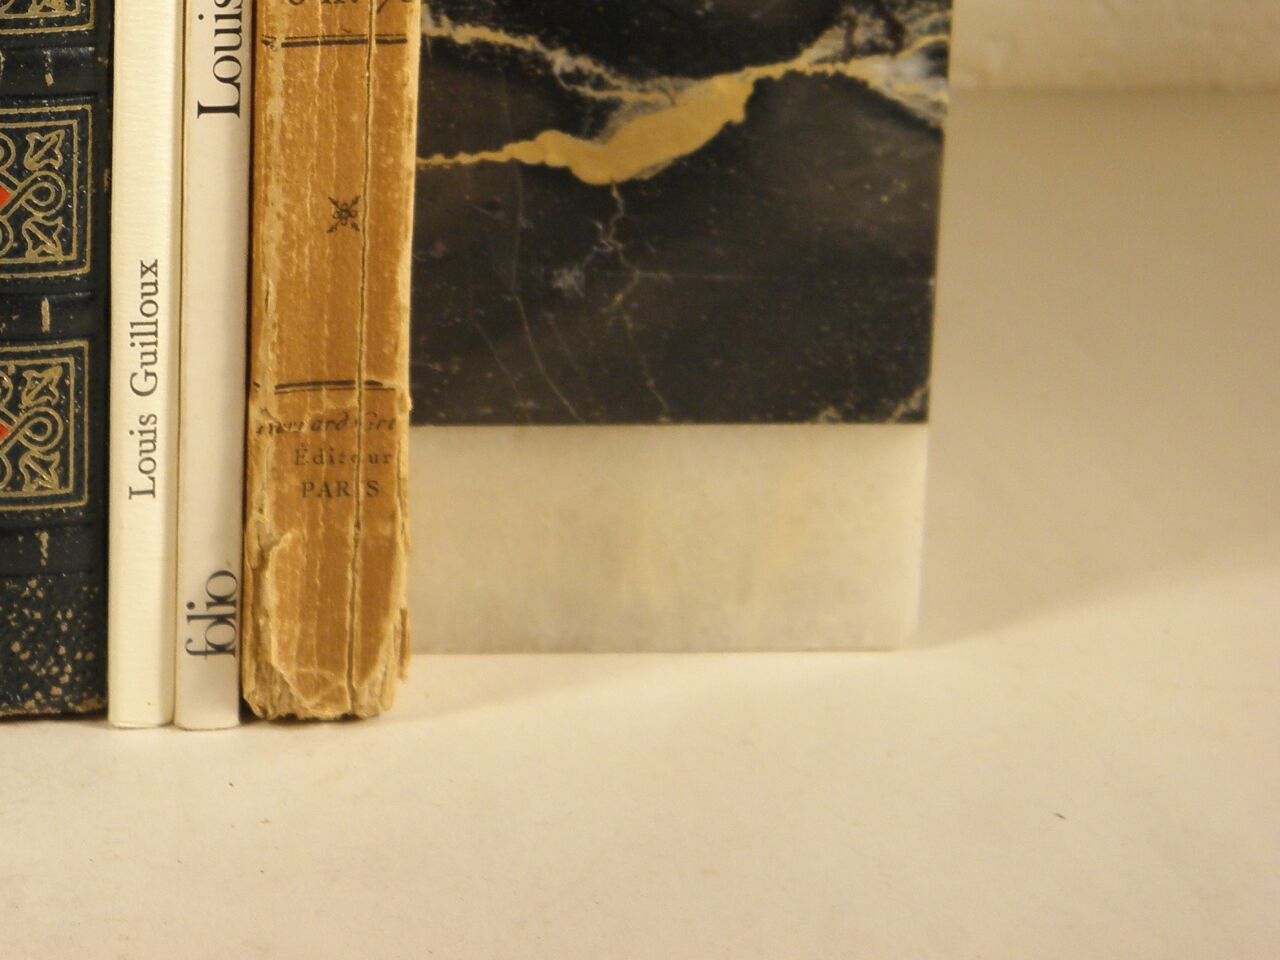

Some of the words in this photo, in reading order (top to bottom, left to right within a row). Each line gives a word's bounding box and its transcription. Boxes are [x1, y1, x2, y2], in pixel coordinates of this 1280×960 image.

[129, 259, 159, 397] Guilloux
[128, 413, 158, 500] Louis
[185, 570, 237, 660] folio
